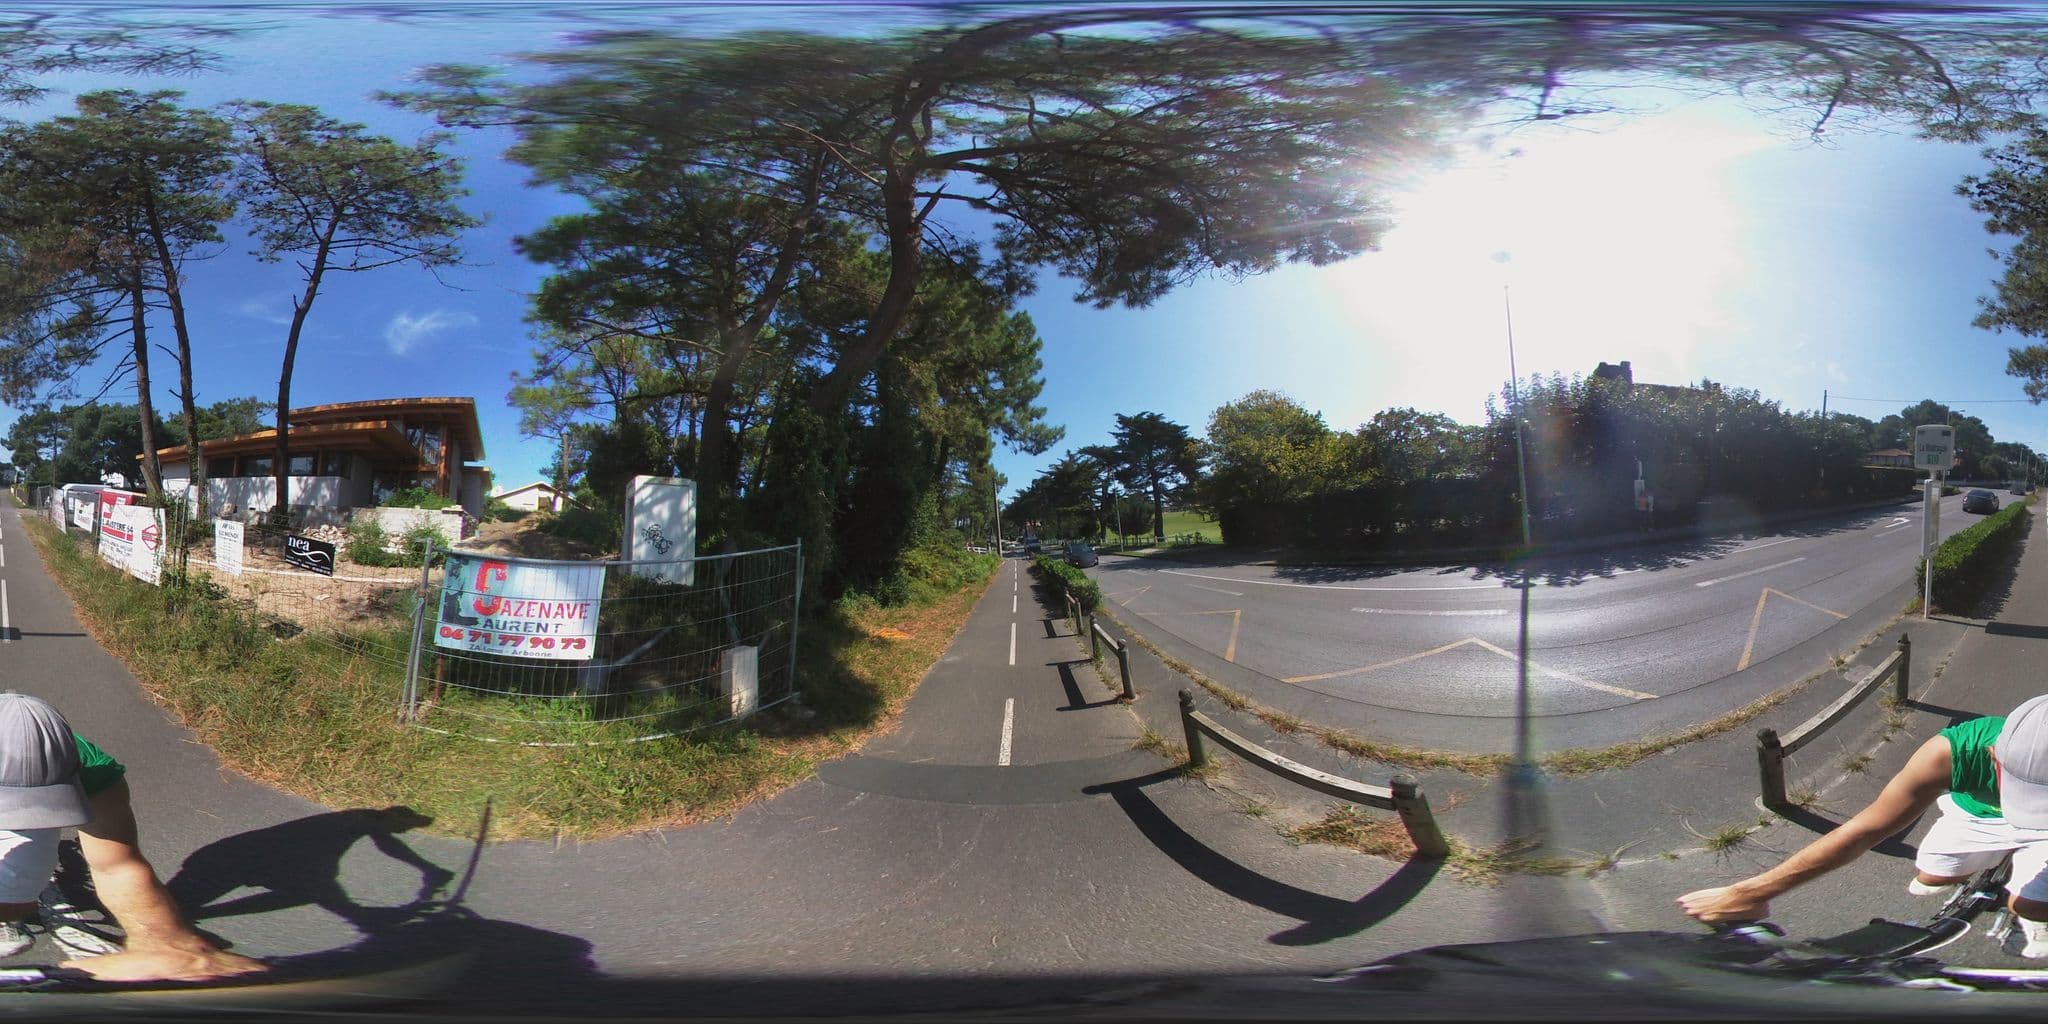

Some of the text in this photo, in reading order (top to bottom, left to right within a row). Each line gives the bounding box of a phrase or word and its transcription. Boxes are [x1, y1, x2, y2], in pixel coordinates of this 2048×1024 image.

[287, 536, 310, 551] nea
[442, 566, 564, 634] LAURENT
[473, 560, 591, 618] CAZENAVE
[439, 626, 587, 650] 06 71 77 90 73
[511, 649, 553, 658] Arbonne
